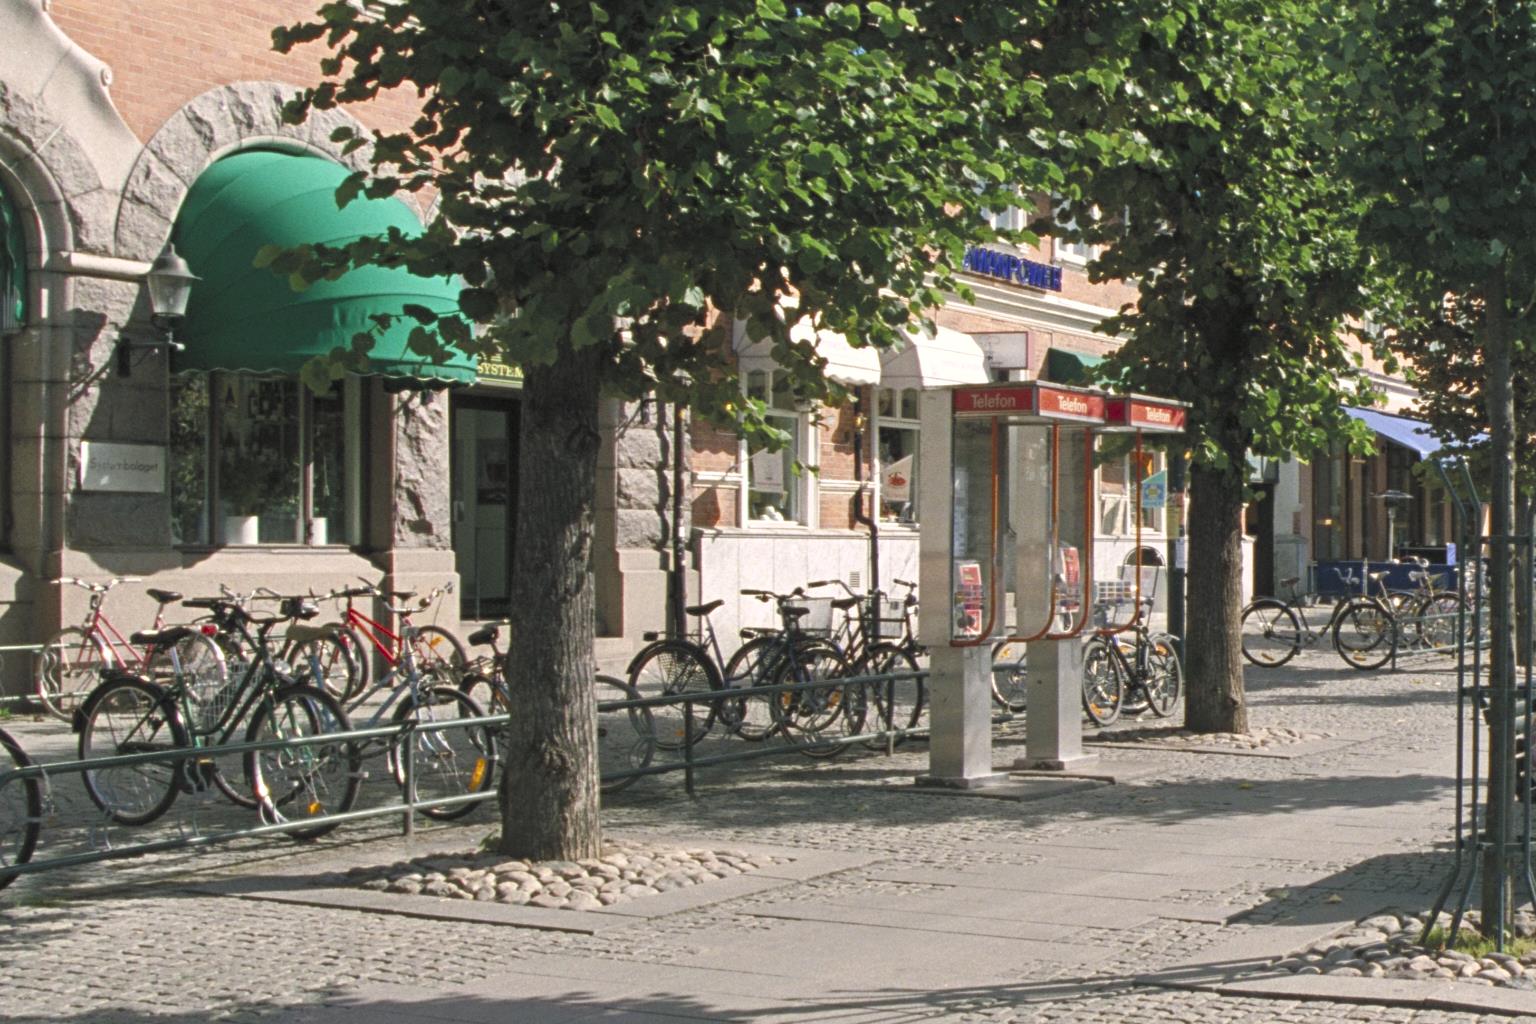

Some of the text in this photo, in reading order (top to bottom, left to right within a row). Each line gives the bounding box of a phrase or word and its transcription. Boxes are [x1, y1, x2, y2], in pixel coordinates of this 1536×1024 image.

[971, 393, 1016, 409] Telefon
[1057, 395, 1087, 415] Telefon
[1145, 406, 1171, 423] Telefon
